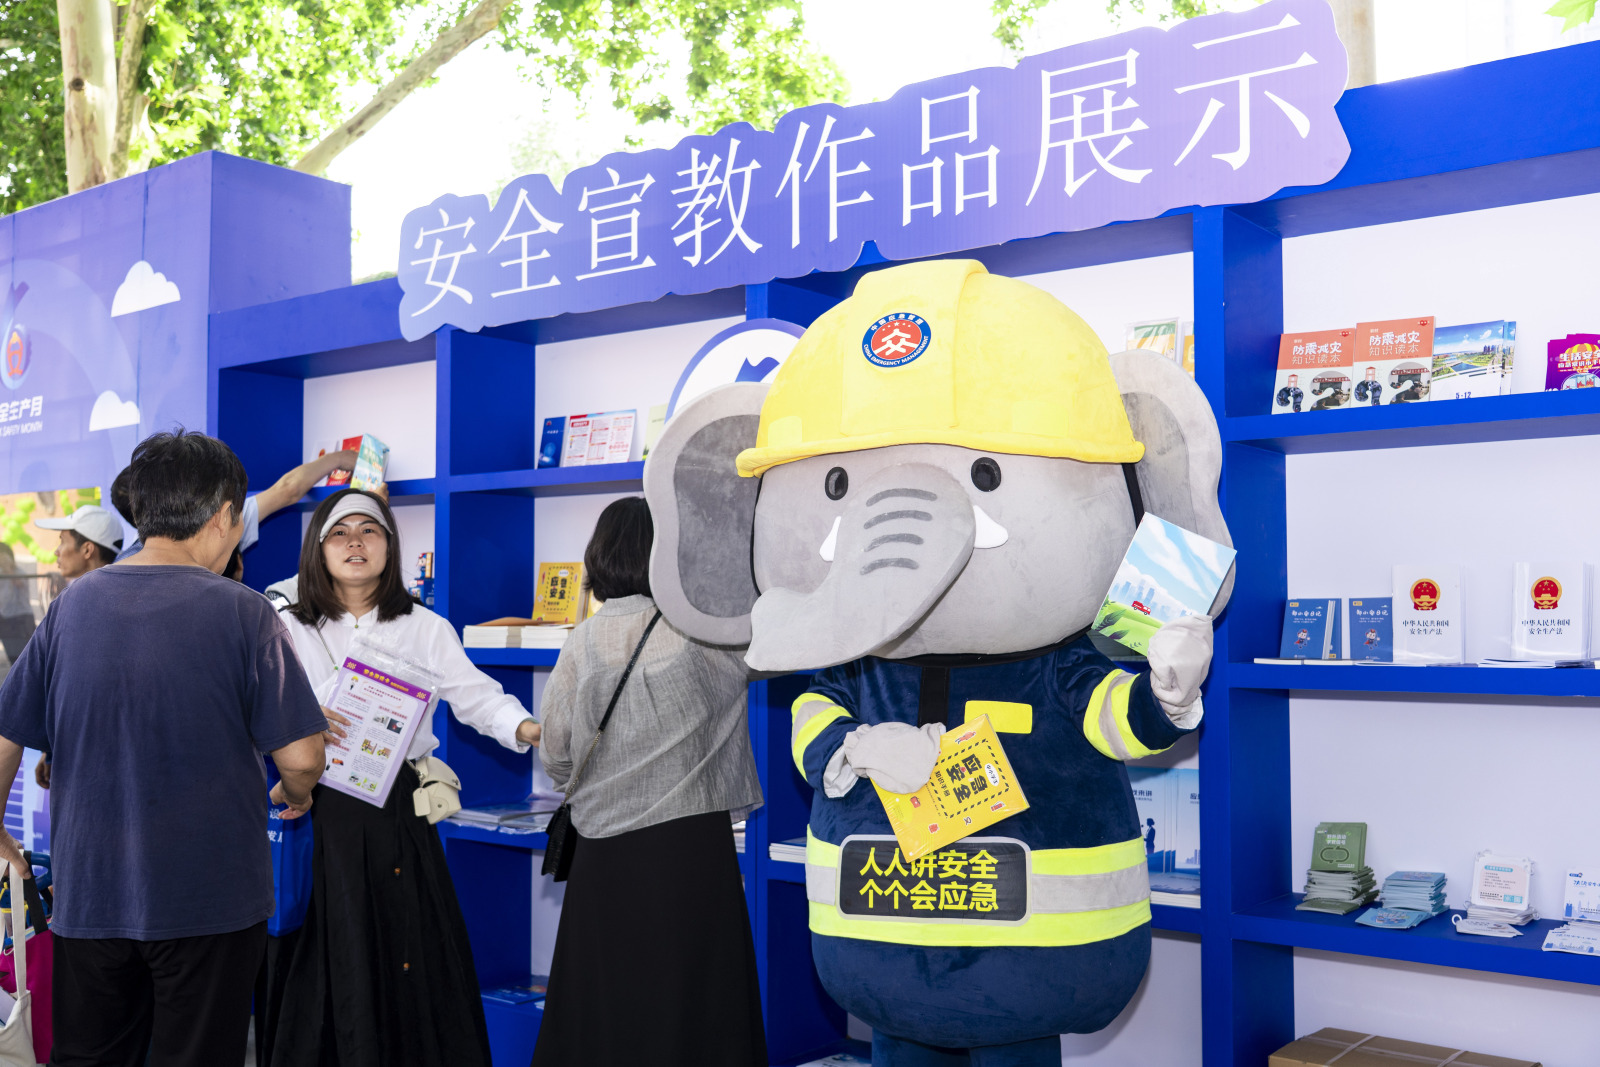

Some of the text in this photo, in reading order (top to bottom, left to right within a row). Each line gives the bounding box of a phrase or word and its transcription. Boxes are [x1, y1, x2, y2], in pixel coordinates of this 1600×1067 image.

[410, 11, 1319, 318] 安全宣教作品展示
[1369, 330, 1421, 346] 防震减灾
[863, 335, 929, 366] CHINA EMERGENCY MANAGEMENT
[1292, 341, 1342, 355] 防震减灾
[1369, 343, 1419, 357] 知识读本
[1292, 353, 1341, 365] 知识读本
[1402, 619, 1449, 627] 中华人民共和国
[1522, 619, 1571, 627] 中华人民共和国
[859, 847, 999, 879] 人人讲安全
[859, 879, 999, 912] 个个会应急
